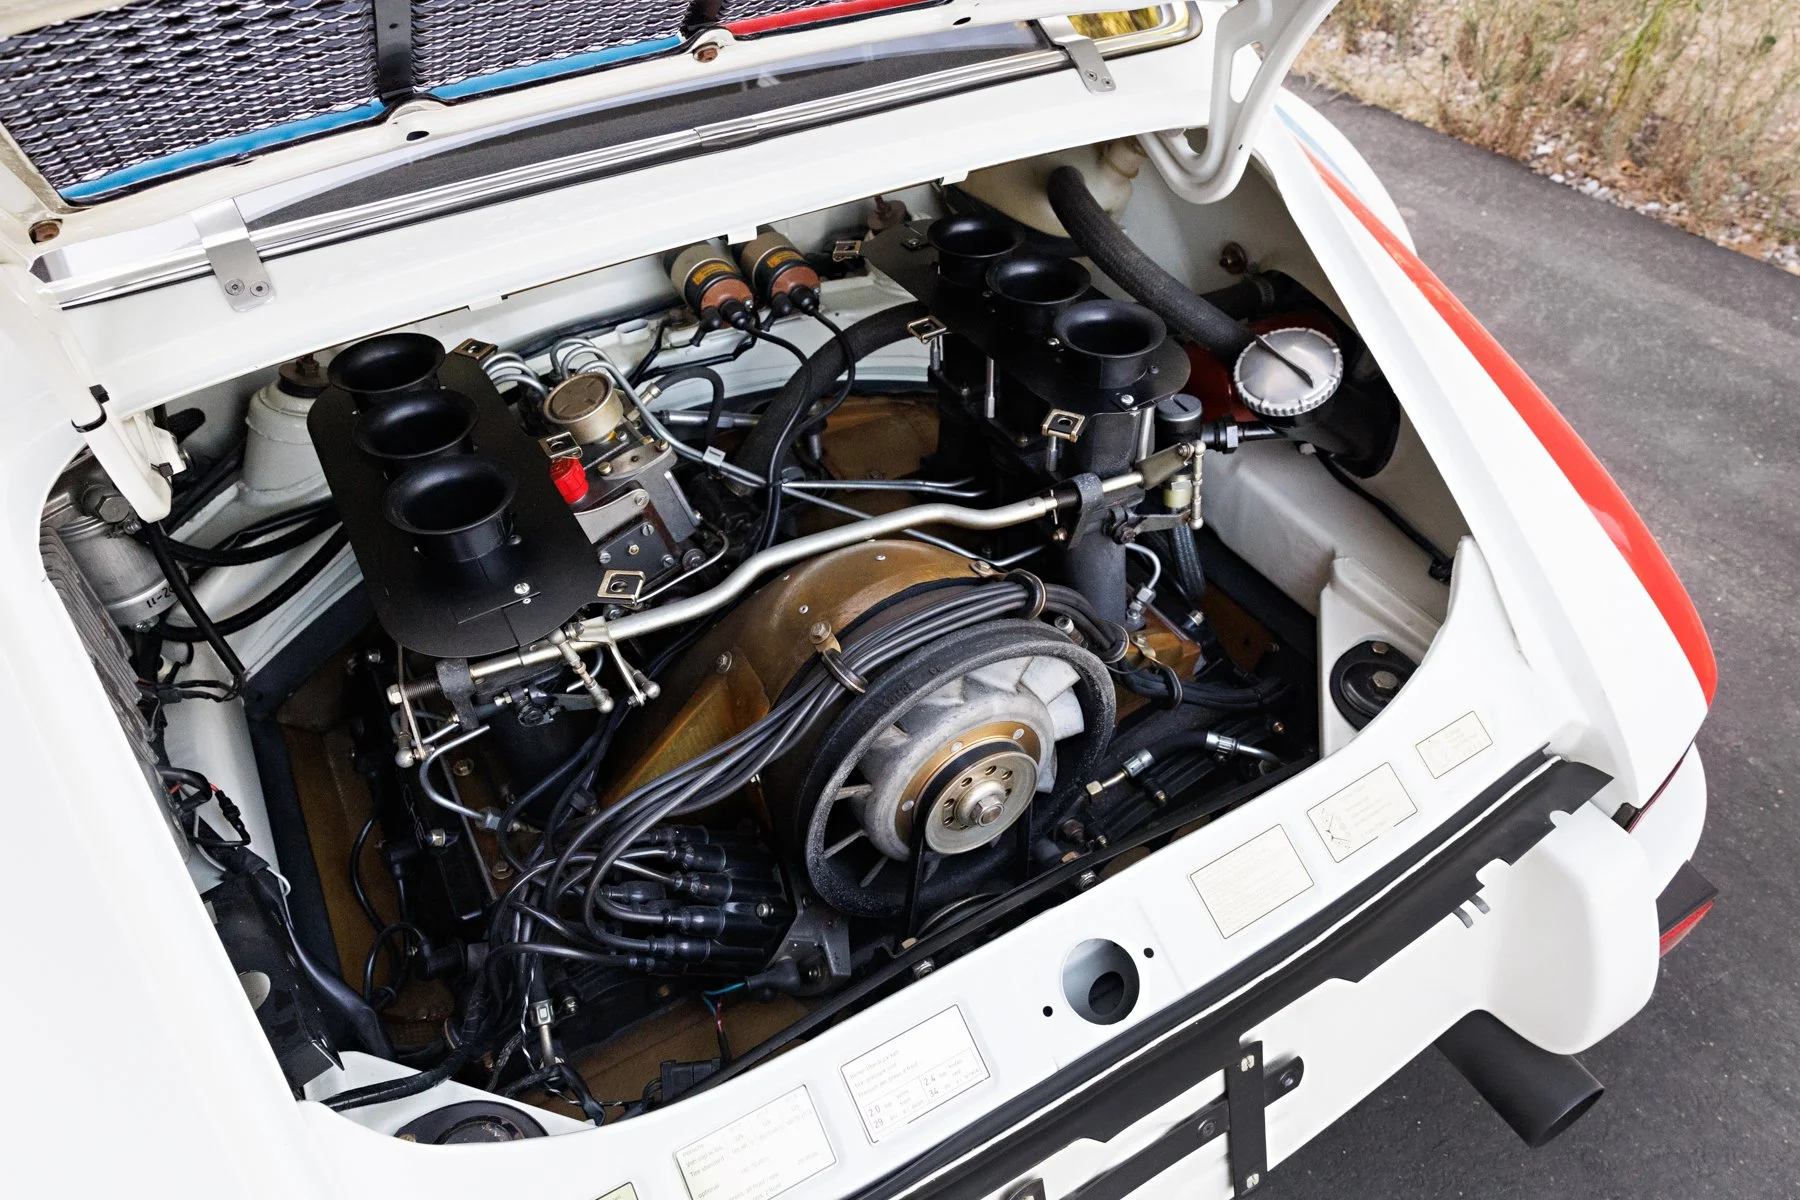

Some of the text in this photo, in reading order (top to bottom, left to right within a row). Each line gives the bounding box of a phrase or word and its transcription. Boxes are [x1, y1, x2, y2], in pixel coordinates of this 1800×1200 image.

[924, 1074, 936, 1086] 2.4
[929, 1087, 939, 1097] 34
[869, 1105, 881, 1116] 2.0
[874, 1118, 884, 1128] 29
